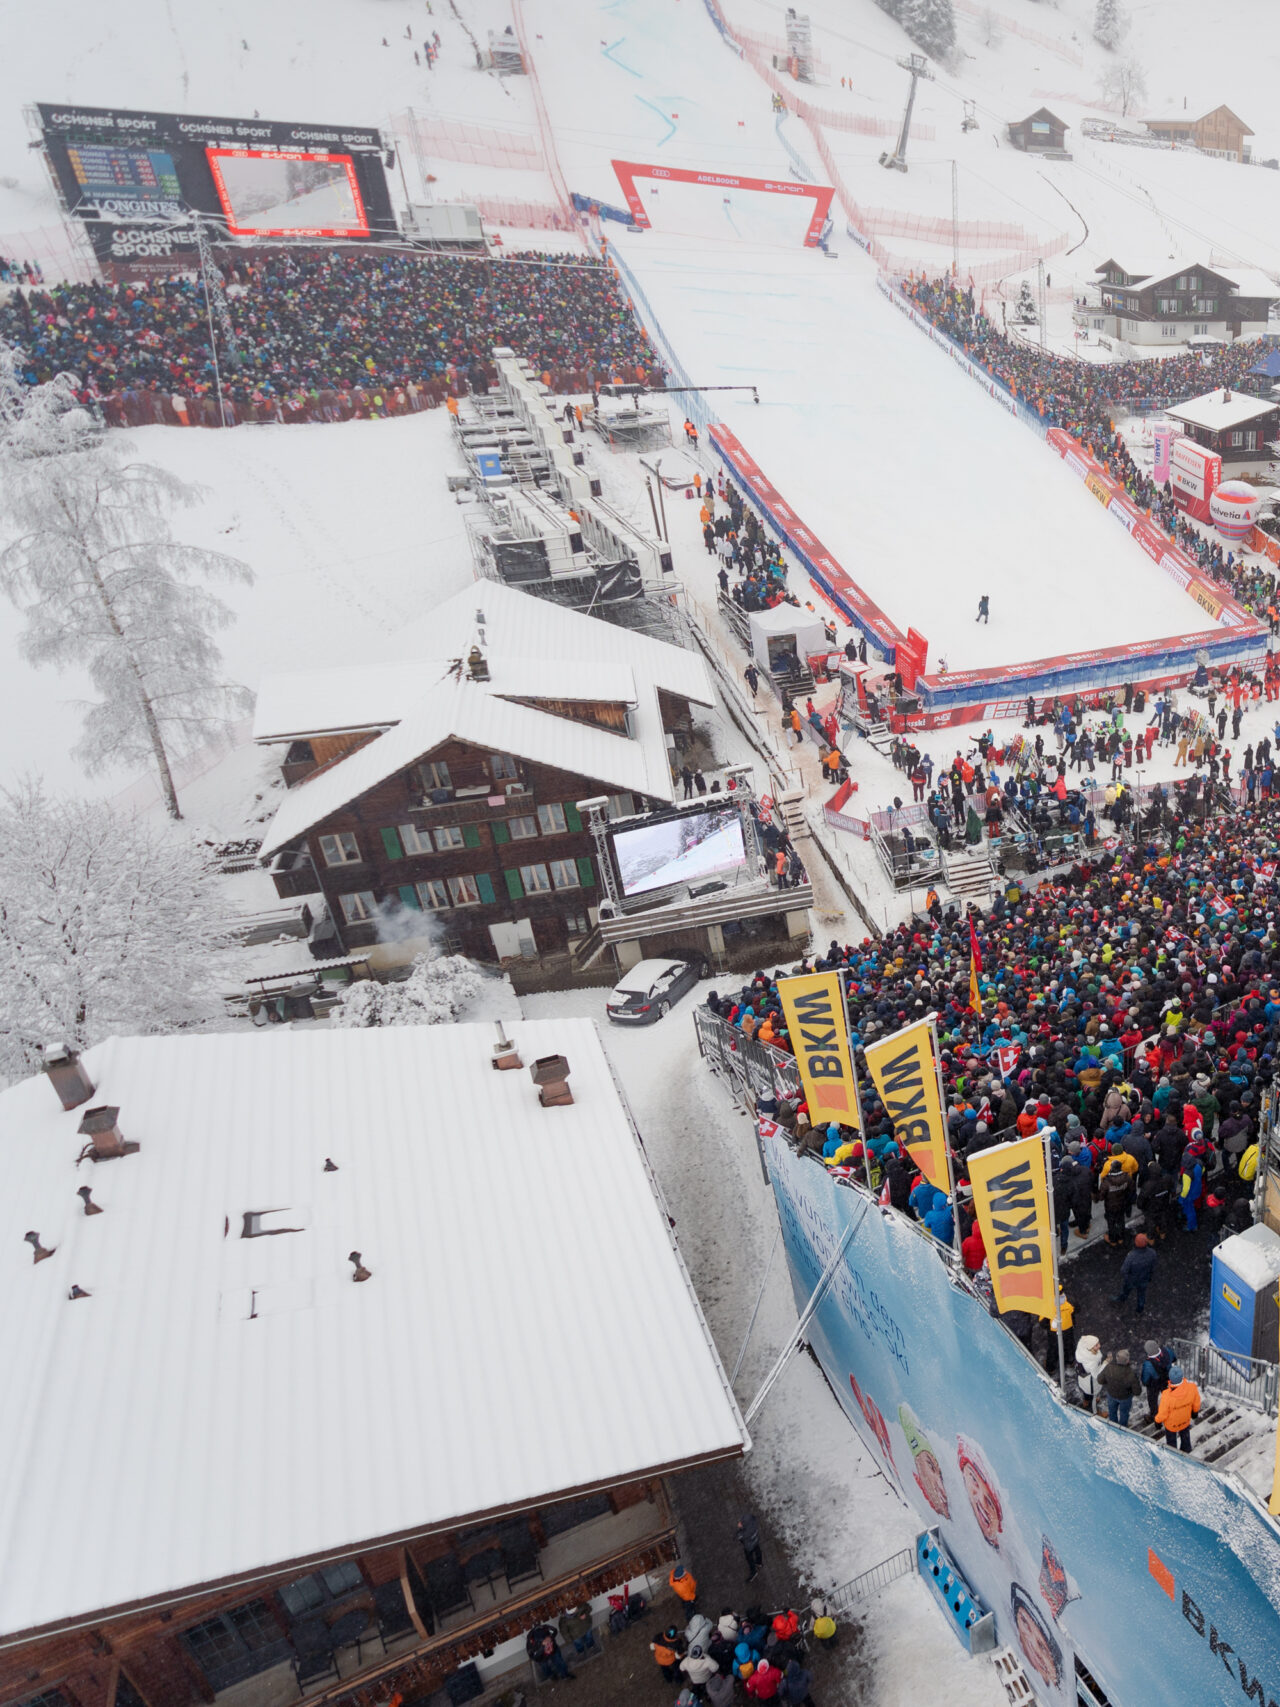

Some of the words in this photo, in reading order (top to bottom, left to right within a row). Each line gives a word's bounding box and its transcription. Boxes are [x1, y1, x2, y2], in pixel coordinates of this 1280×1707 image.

[116, 118, 157, 130] SPORT
[236, 127, 272, 138] SPORT
[342, 134, 373, 144] SPORT
[261, 152, 302, 160] e-tron
[697, 175, 740, 186] ADELBODEN
[765, 183, 804, 193] e-tron
[92, 200, 181, 213] LONGINES
[111, 244, 172, 257] SPORT
[1181, 477, 1198, 491] BKW
[1091, 483, 1107, 505] BKW
[1210, 504, 1241, 521] helvetia
[1197, 594, 1216, 616] BKW
[793, 988, 844, 1079] BKW
[880, 1044, 933, 1147] BKW
[986, 1160, 1042, 1270] BKW
